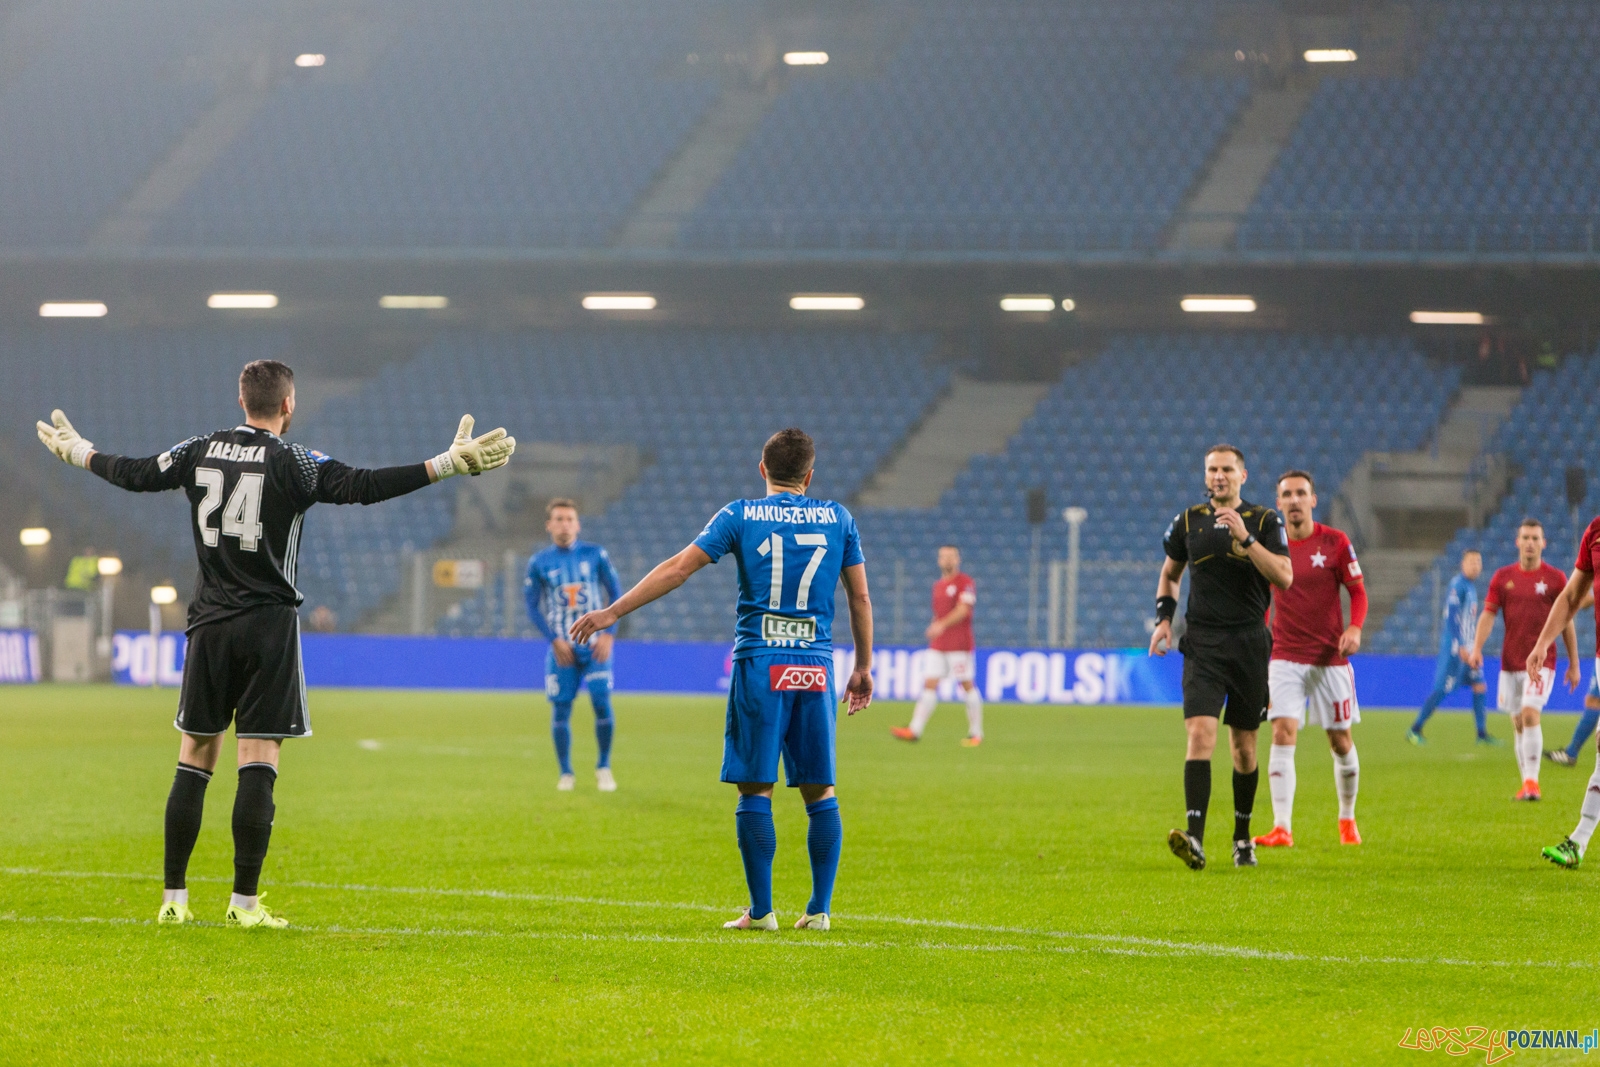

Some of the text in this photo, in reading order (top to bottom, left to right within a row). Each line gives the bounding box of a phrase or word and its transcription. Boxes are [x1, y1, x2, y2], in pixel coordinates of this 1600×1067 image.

[195, 467, 265, 552] 24
[743, 505, 838, 524] MAKUSZEWSKI
[756, 532, 828, 611] 17
[557, 583, 588, 608] STS
[767, 619, 810, 638] LECH
[1333, 698, 1352, 723] 10
